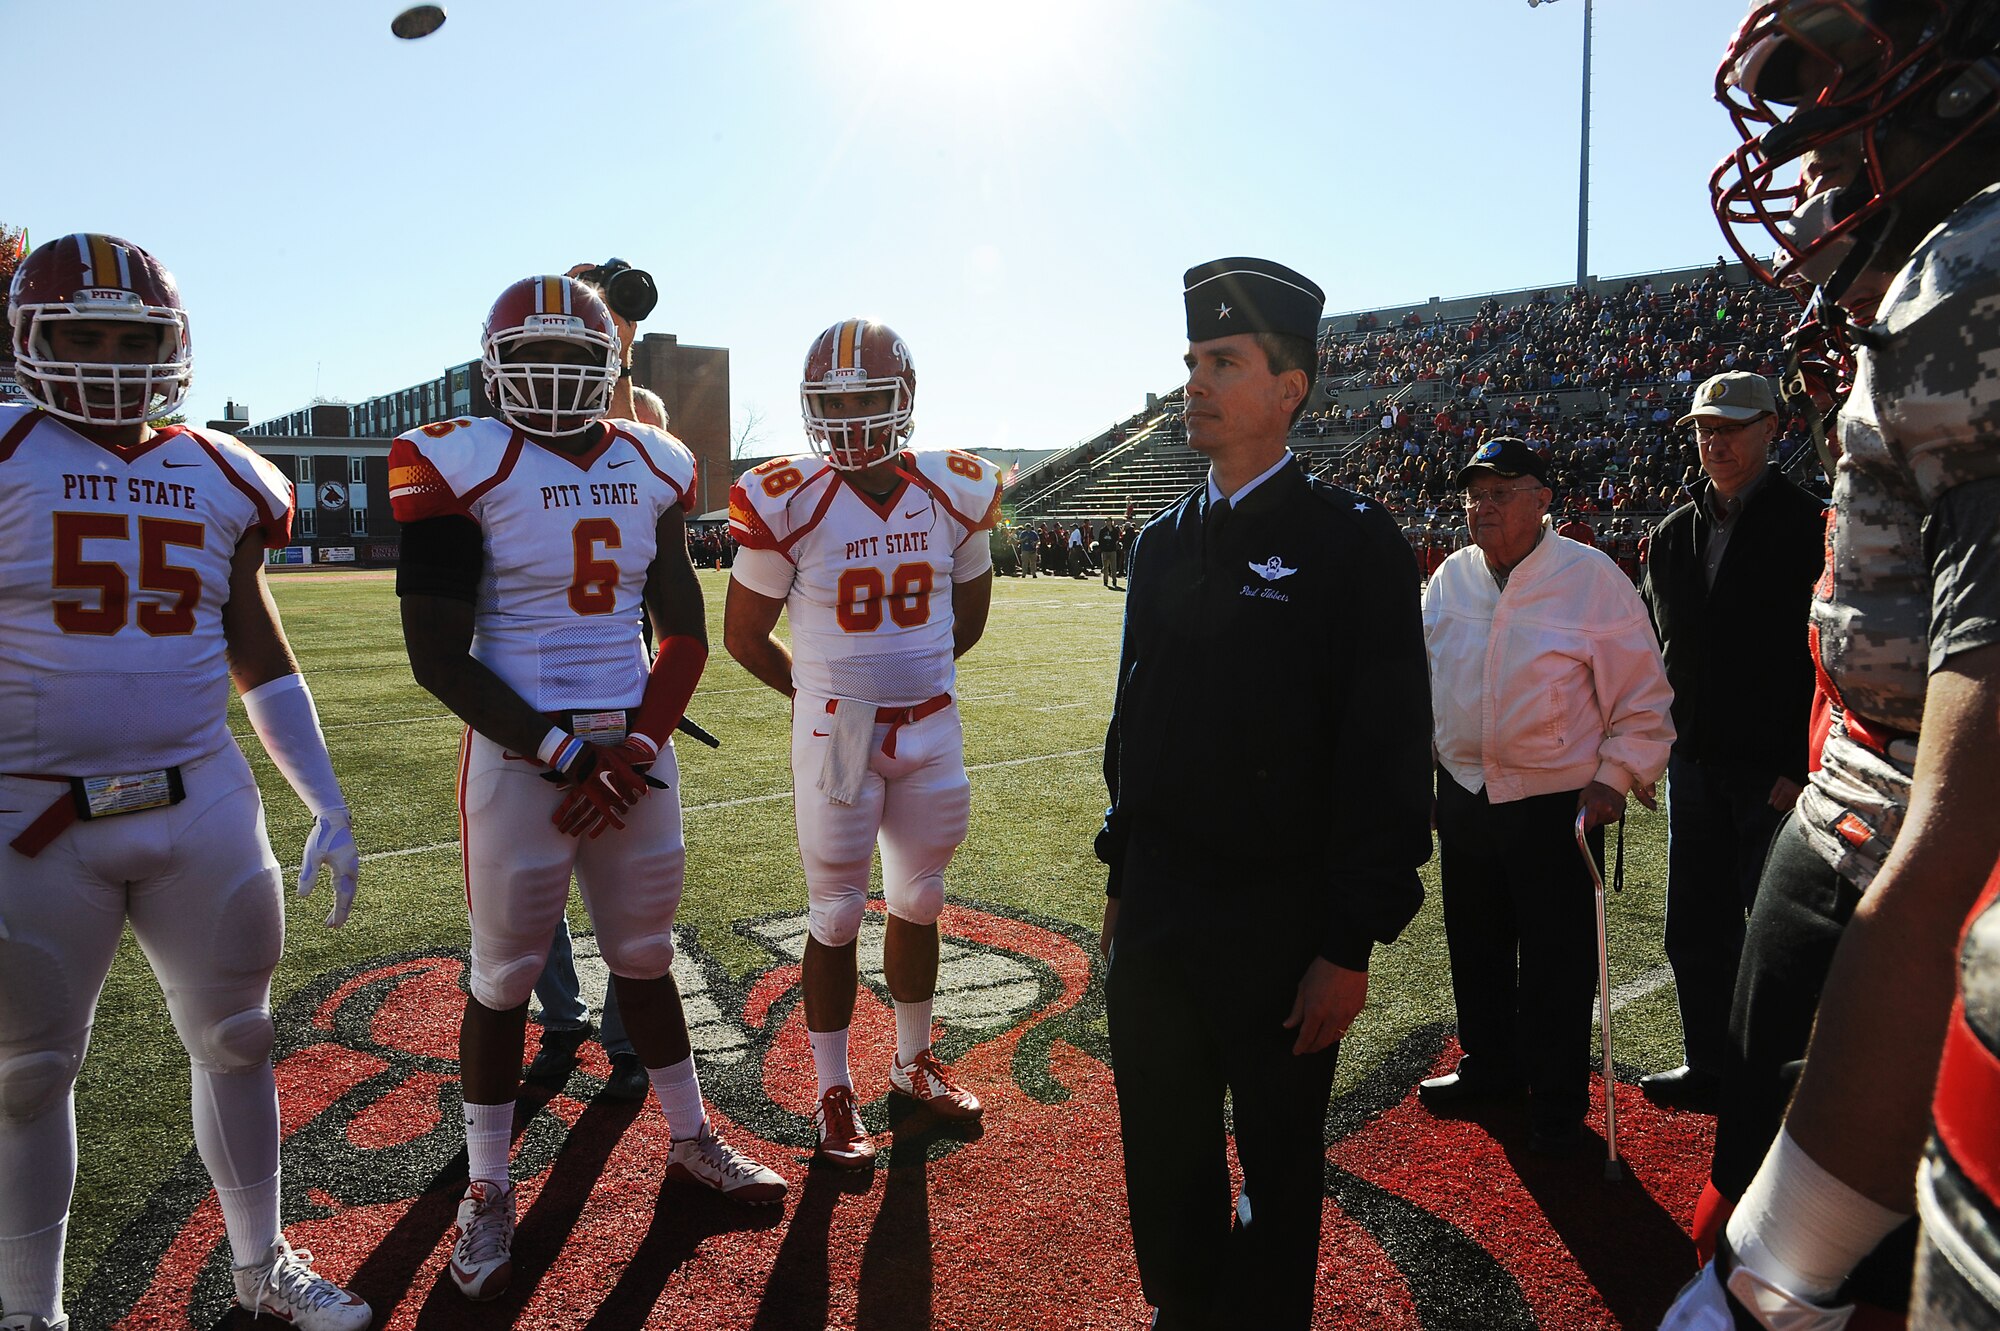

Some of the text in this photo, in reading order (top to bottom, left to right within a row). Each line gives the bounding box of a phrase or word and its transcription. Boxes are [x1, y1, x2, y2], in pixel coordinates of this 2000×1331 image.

[91, 290, 123, 300] PITT
[542, 317, 567, 325] PITT
[835, 369, 855, 377] PITT
[63, 474, 196, 510] PITT STATE
[540, 483, 638, 510] PITT STATE
[845, 531, 929, 560] PITT STATE
[52, 511, 206, 637] 55
[567, 517, 622, 616] 6
[835, 561, 935, 634] 88
